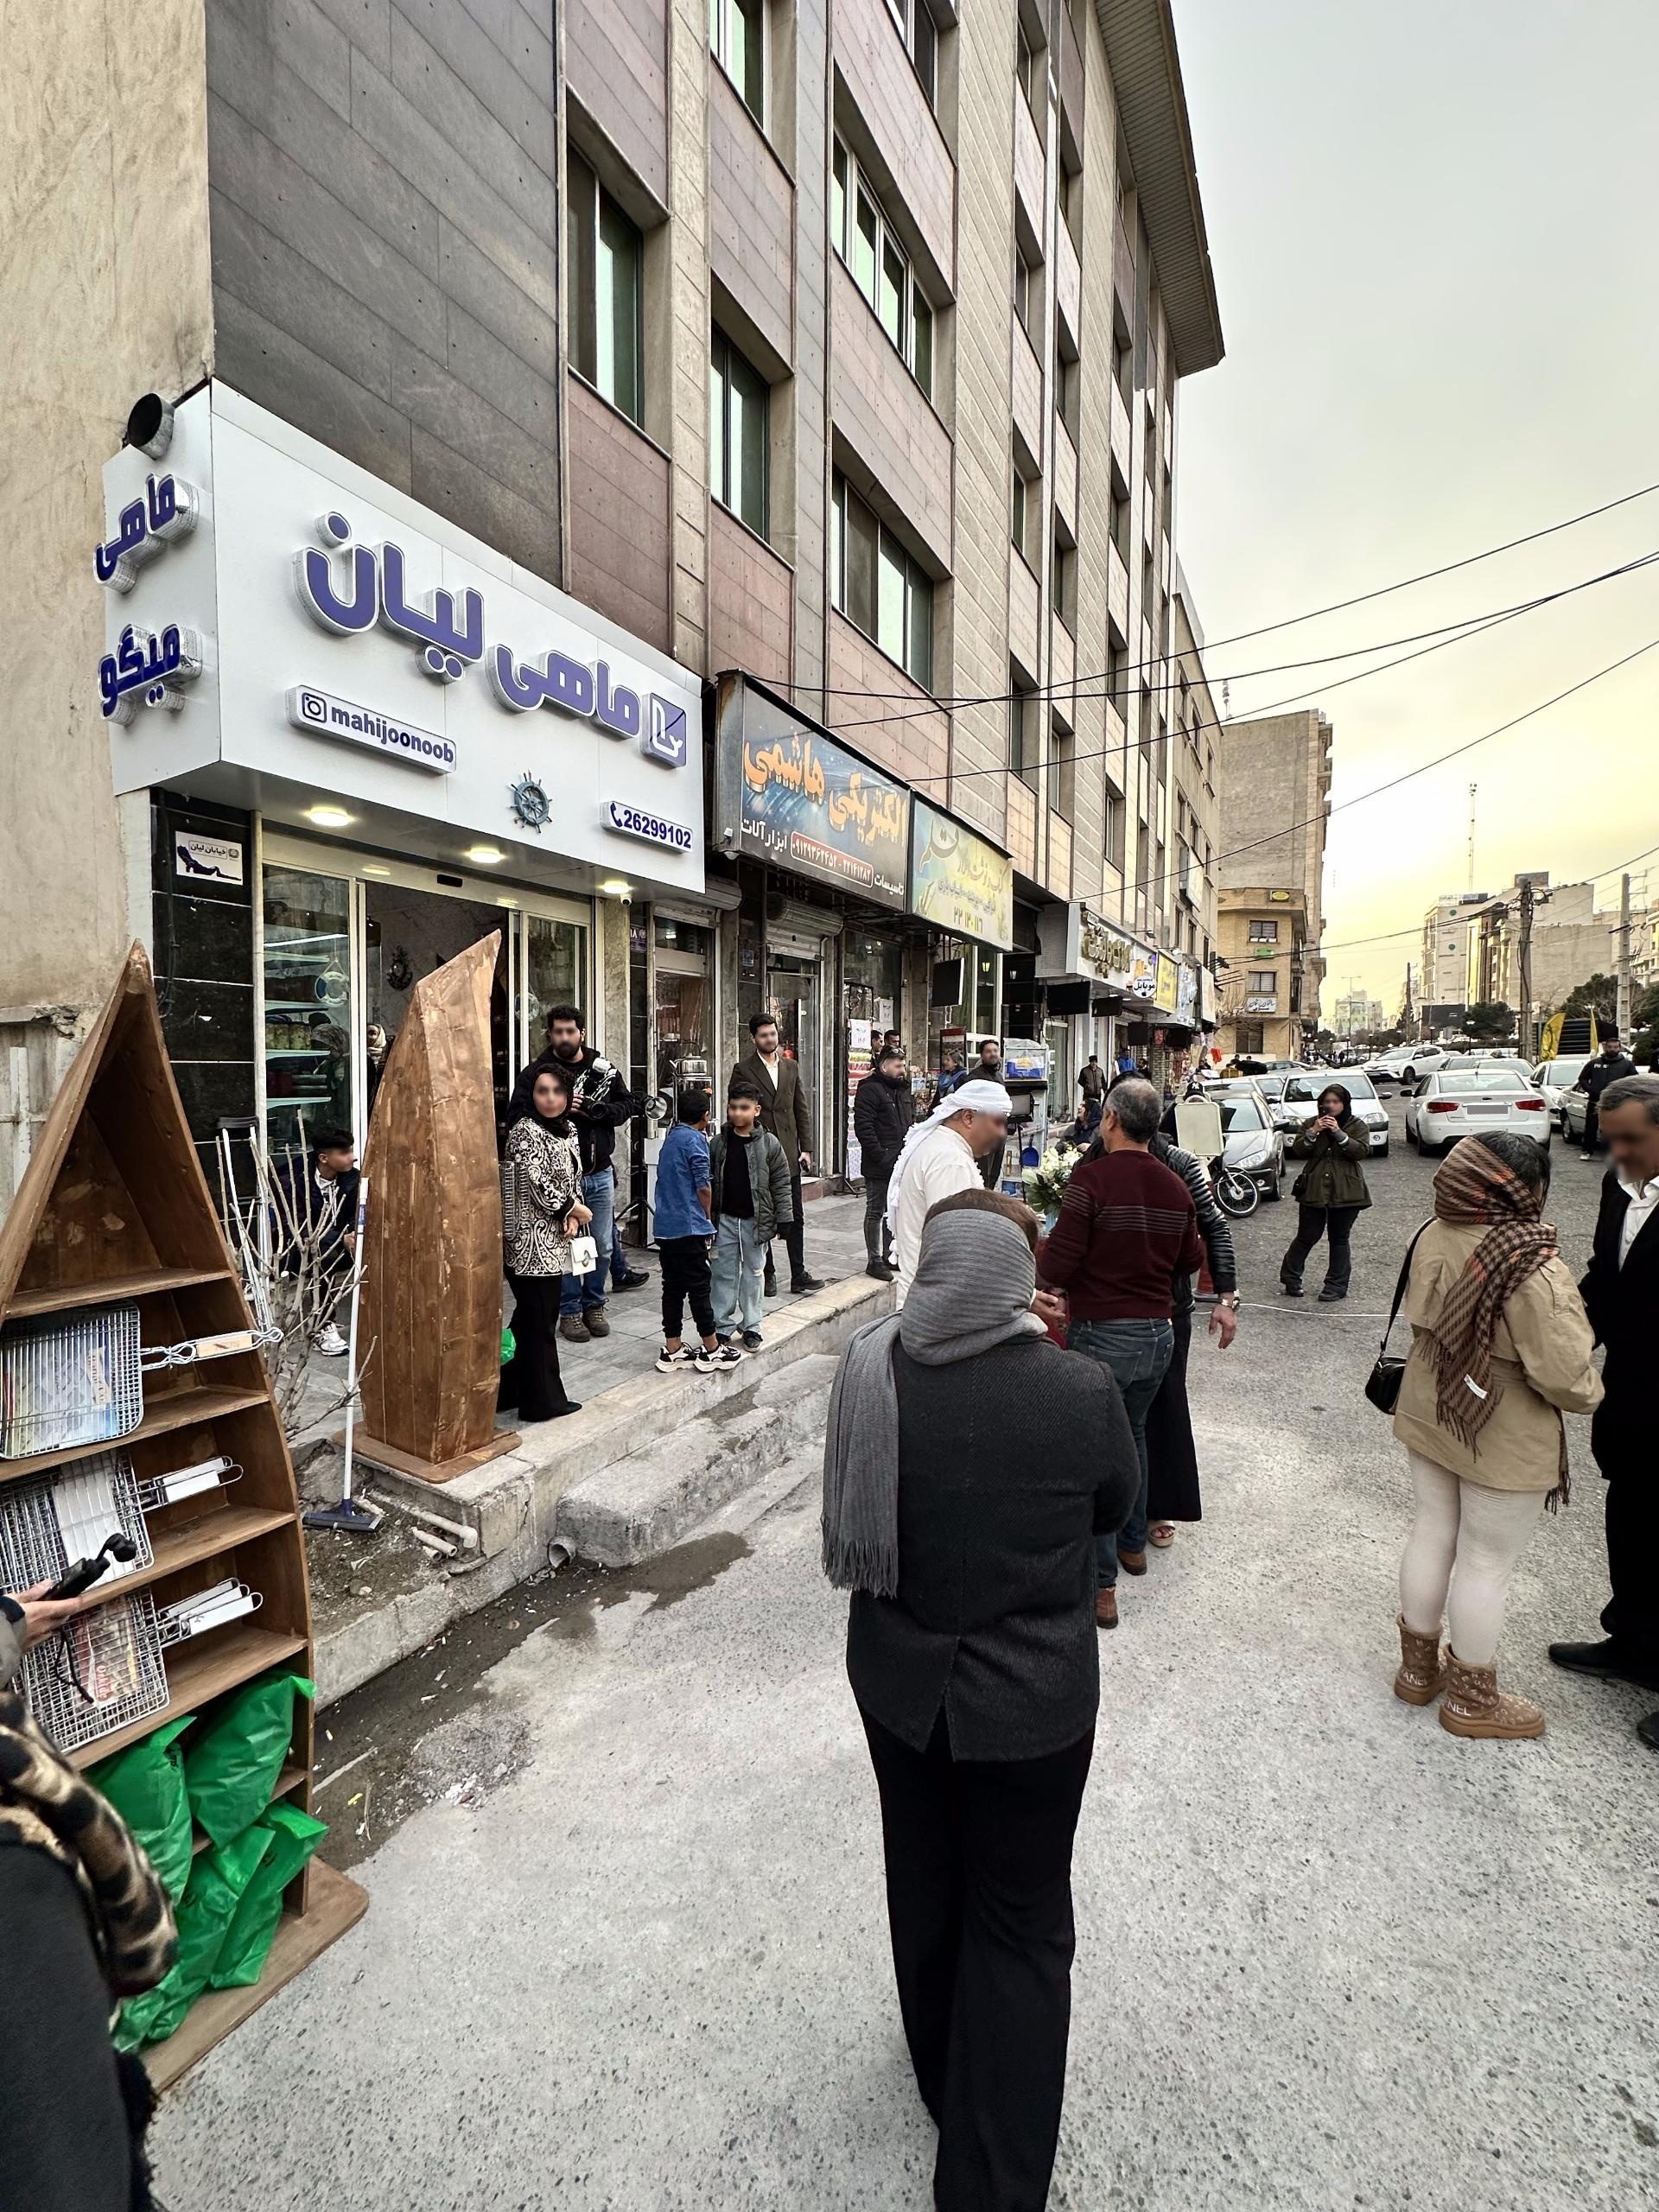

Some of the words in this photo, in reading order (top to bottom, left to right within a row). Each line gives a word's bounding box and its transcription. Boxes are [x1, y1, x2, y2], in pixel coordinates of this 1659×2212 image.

[93, 473, 179, 586] ماهی
[299, 512, 486, 683] لیان
[97, 624, 181, 719] میگو
[489, 643, 641, 739] ماهی
[331, 703, 454, 763] mahijoonoob
[743, 731, 826, 806] هاشمی
[623, 809, 692, 849] 26299102
